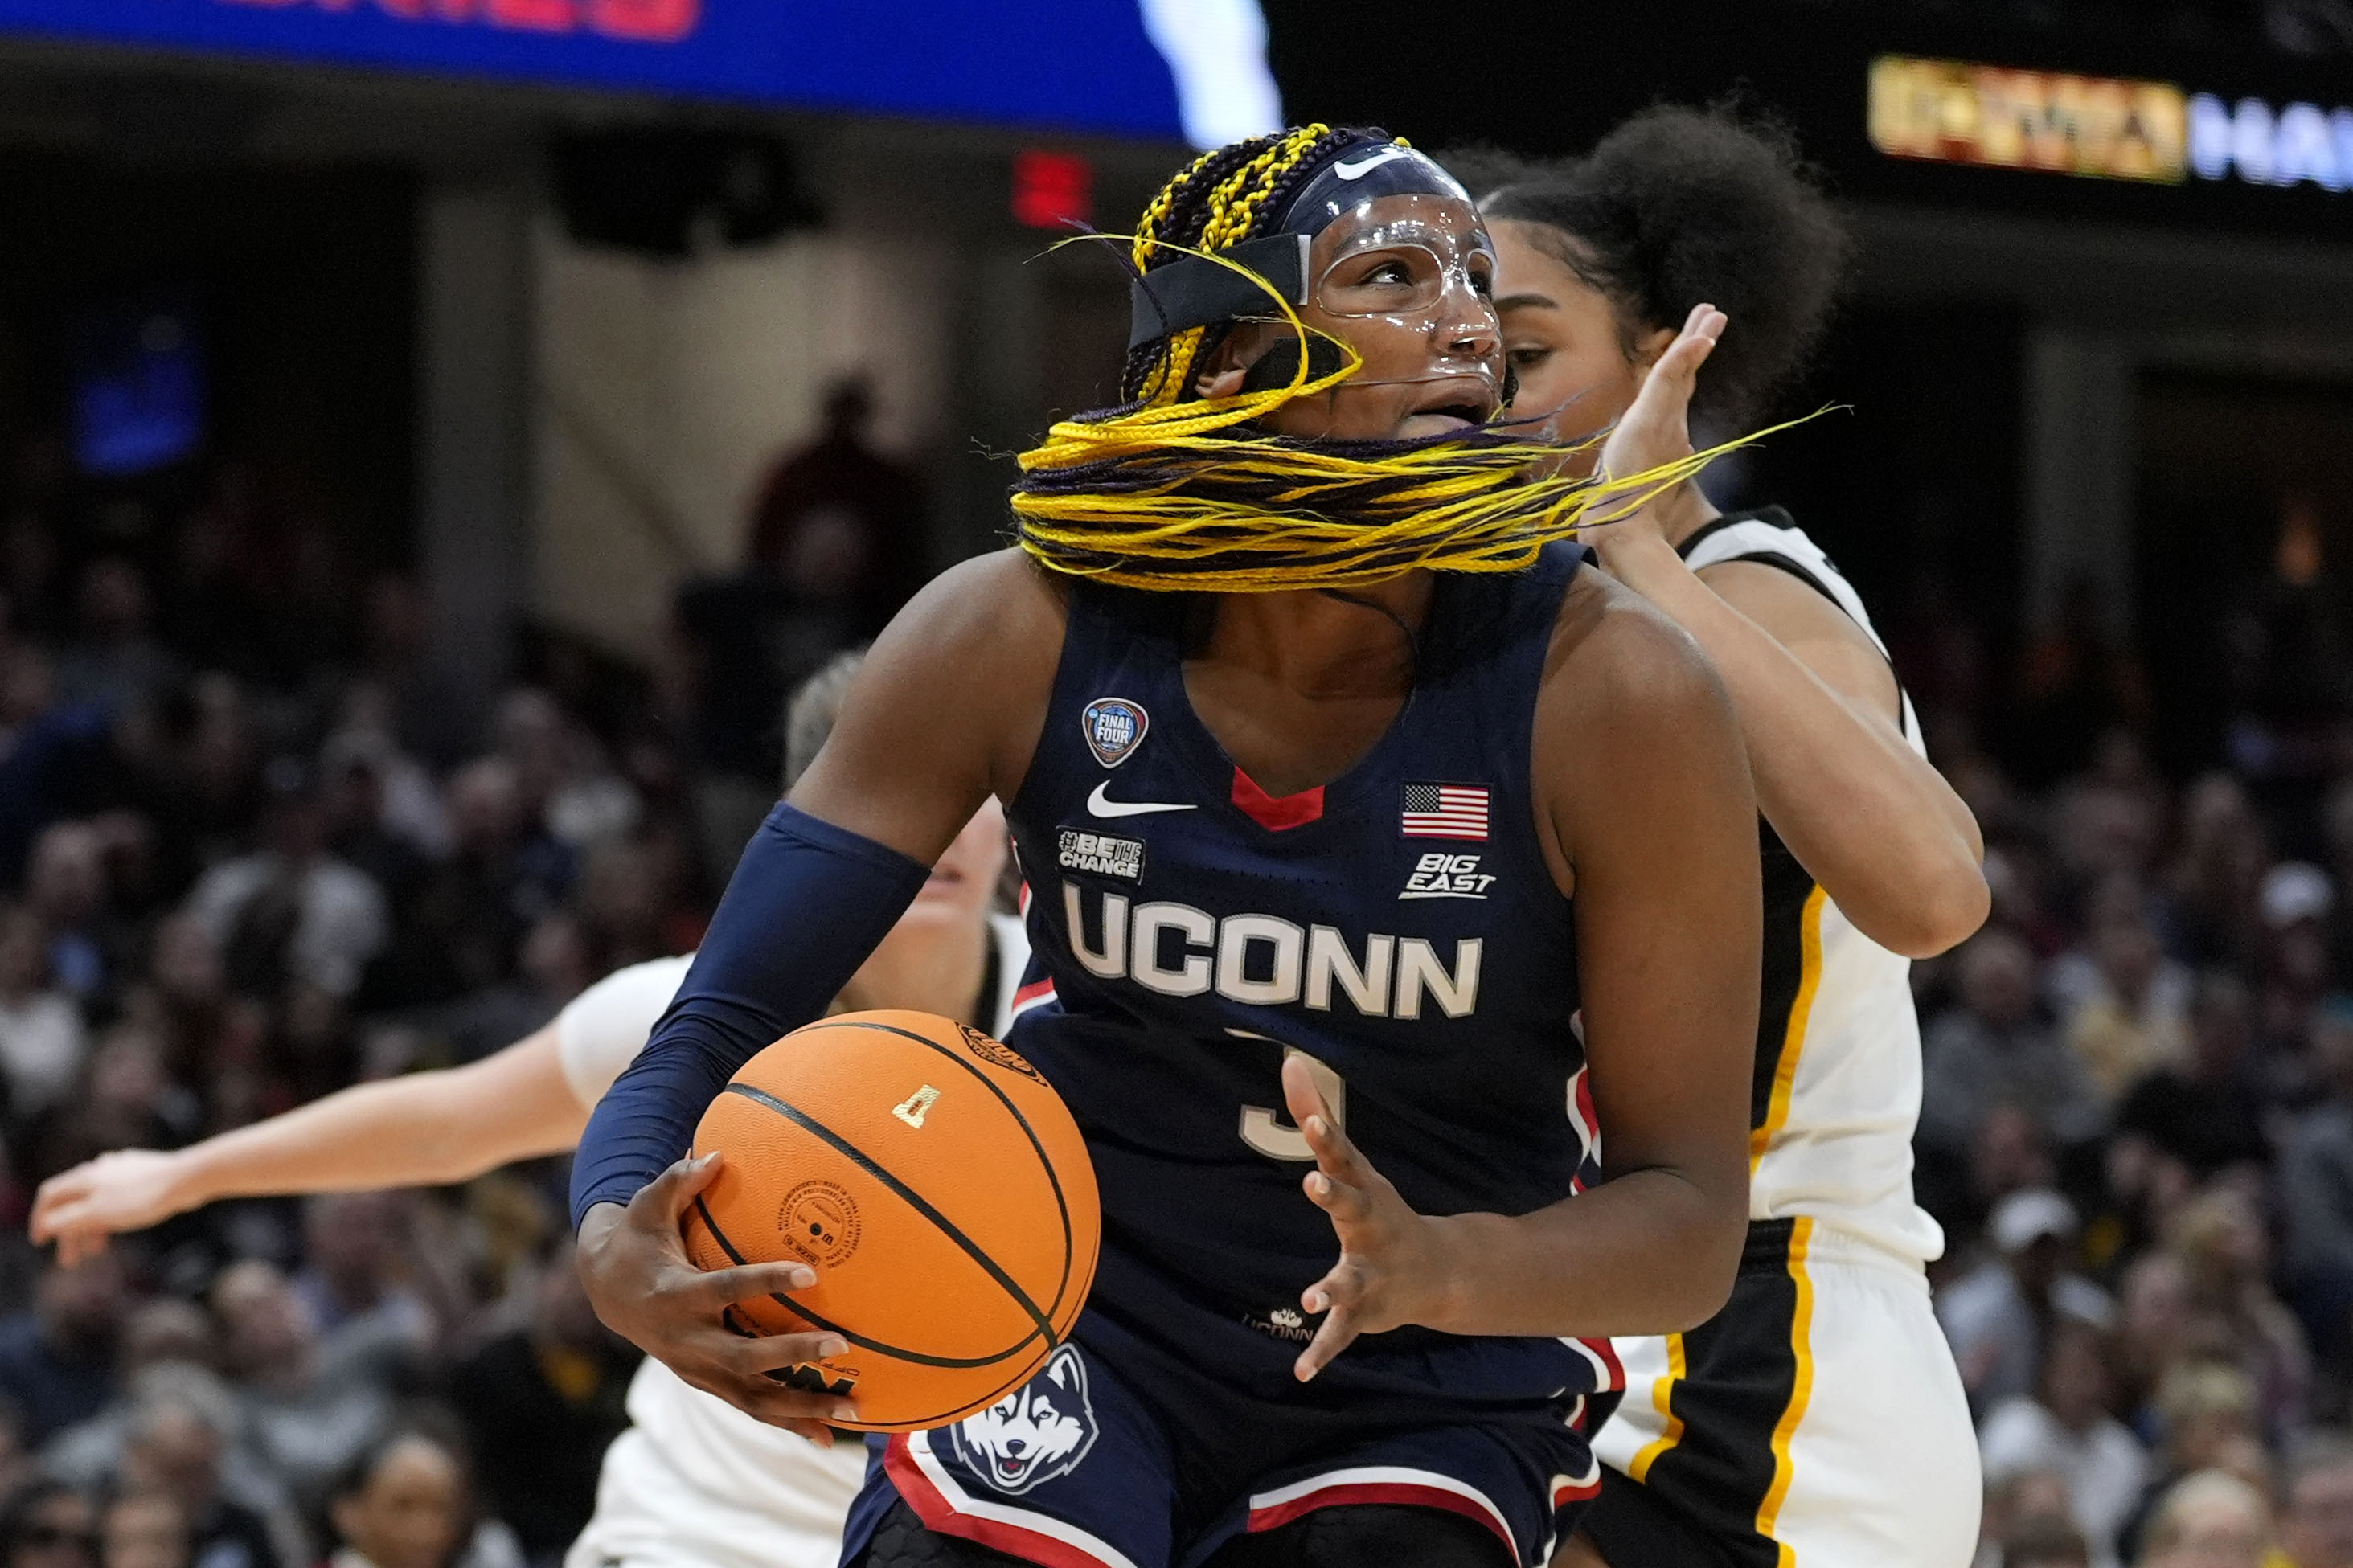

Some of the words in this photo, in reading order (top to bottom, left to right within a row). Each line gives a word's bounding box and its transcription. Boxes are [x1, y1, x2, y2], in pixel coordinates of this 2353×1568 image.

[1098, 714, 1131, 731] FINAL
[1095, 726, 1129, 745] FOUR
[1059, 851, 1140, 878] CHANGE
[1416, 853, 1481, 874] BIG
[1406, 872, 1497, 893] EAST
[1062, 879, 1483, 1021] UCONN
